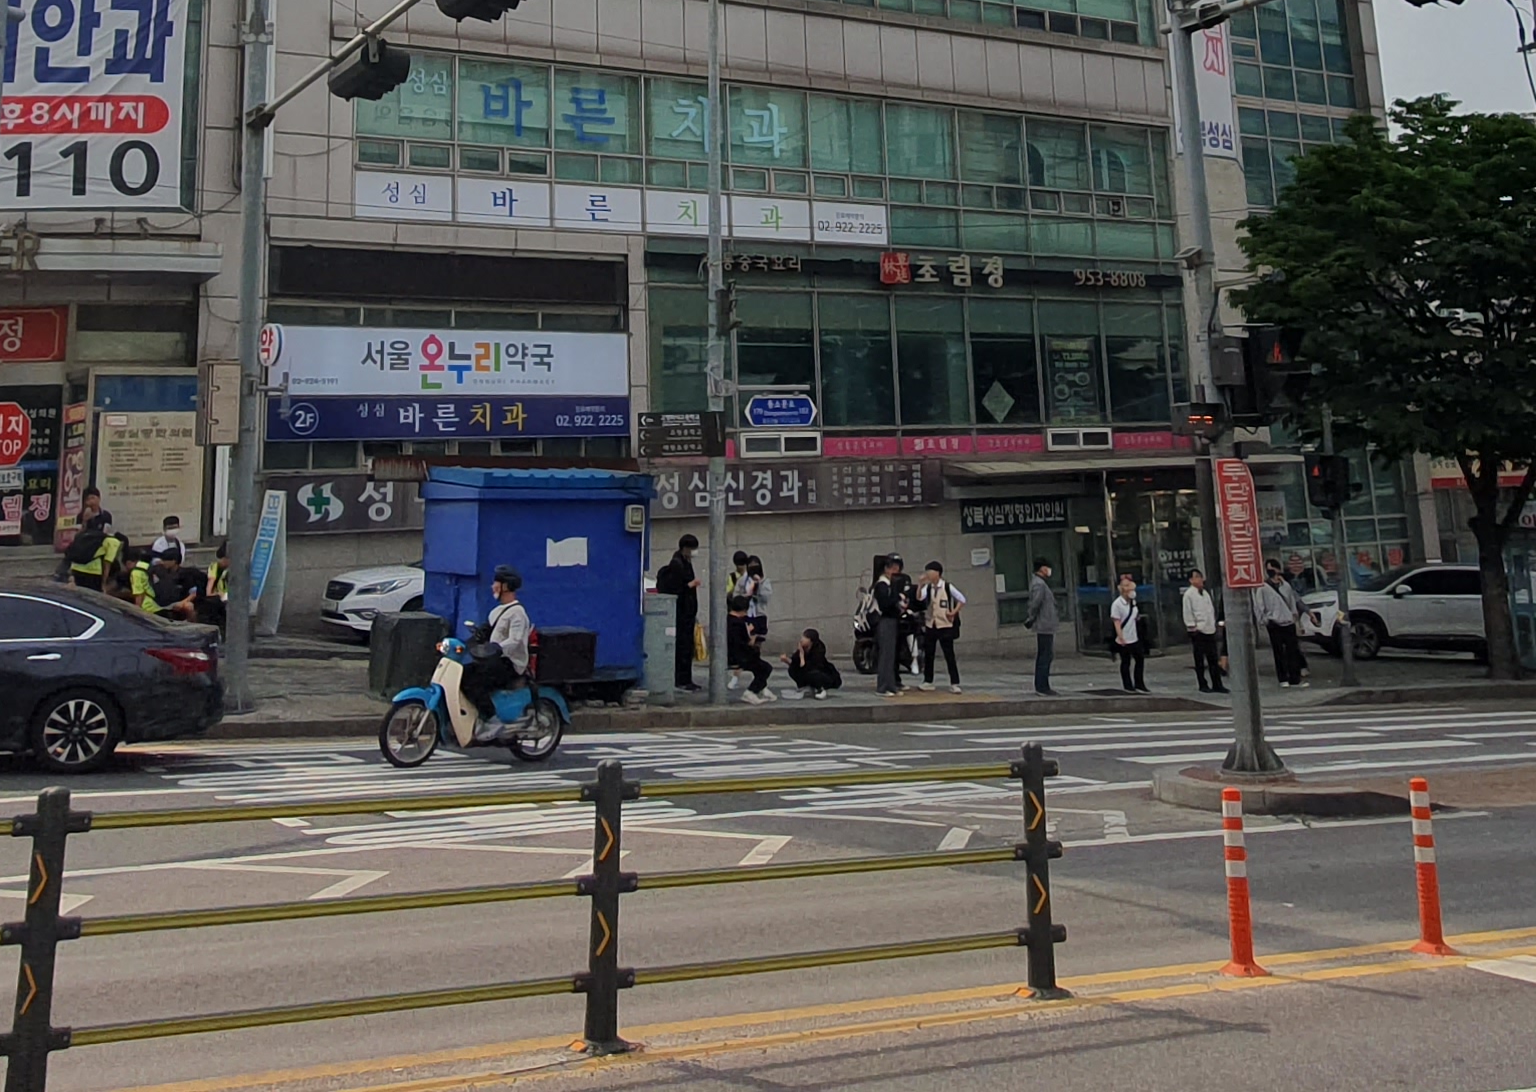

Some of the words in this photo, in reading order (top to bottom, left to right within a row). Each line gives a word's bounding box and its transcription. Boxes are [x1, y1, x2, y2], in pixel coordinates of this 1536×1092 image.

[408, 68, 448, 95] 성심
[380, 180, 428, 207] 성심
[914, 254, 1005, 288] 초림정
[1072, 267, 1147, 288] 953-8808
[294, 410, 315, 428] 2F
[656, 469, 802, 509] 성심신경과
[1221, 462, 1258, 583] 무단횡단금지
